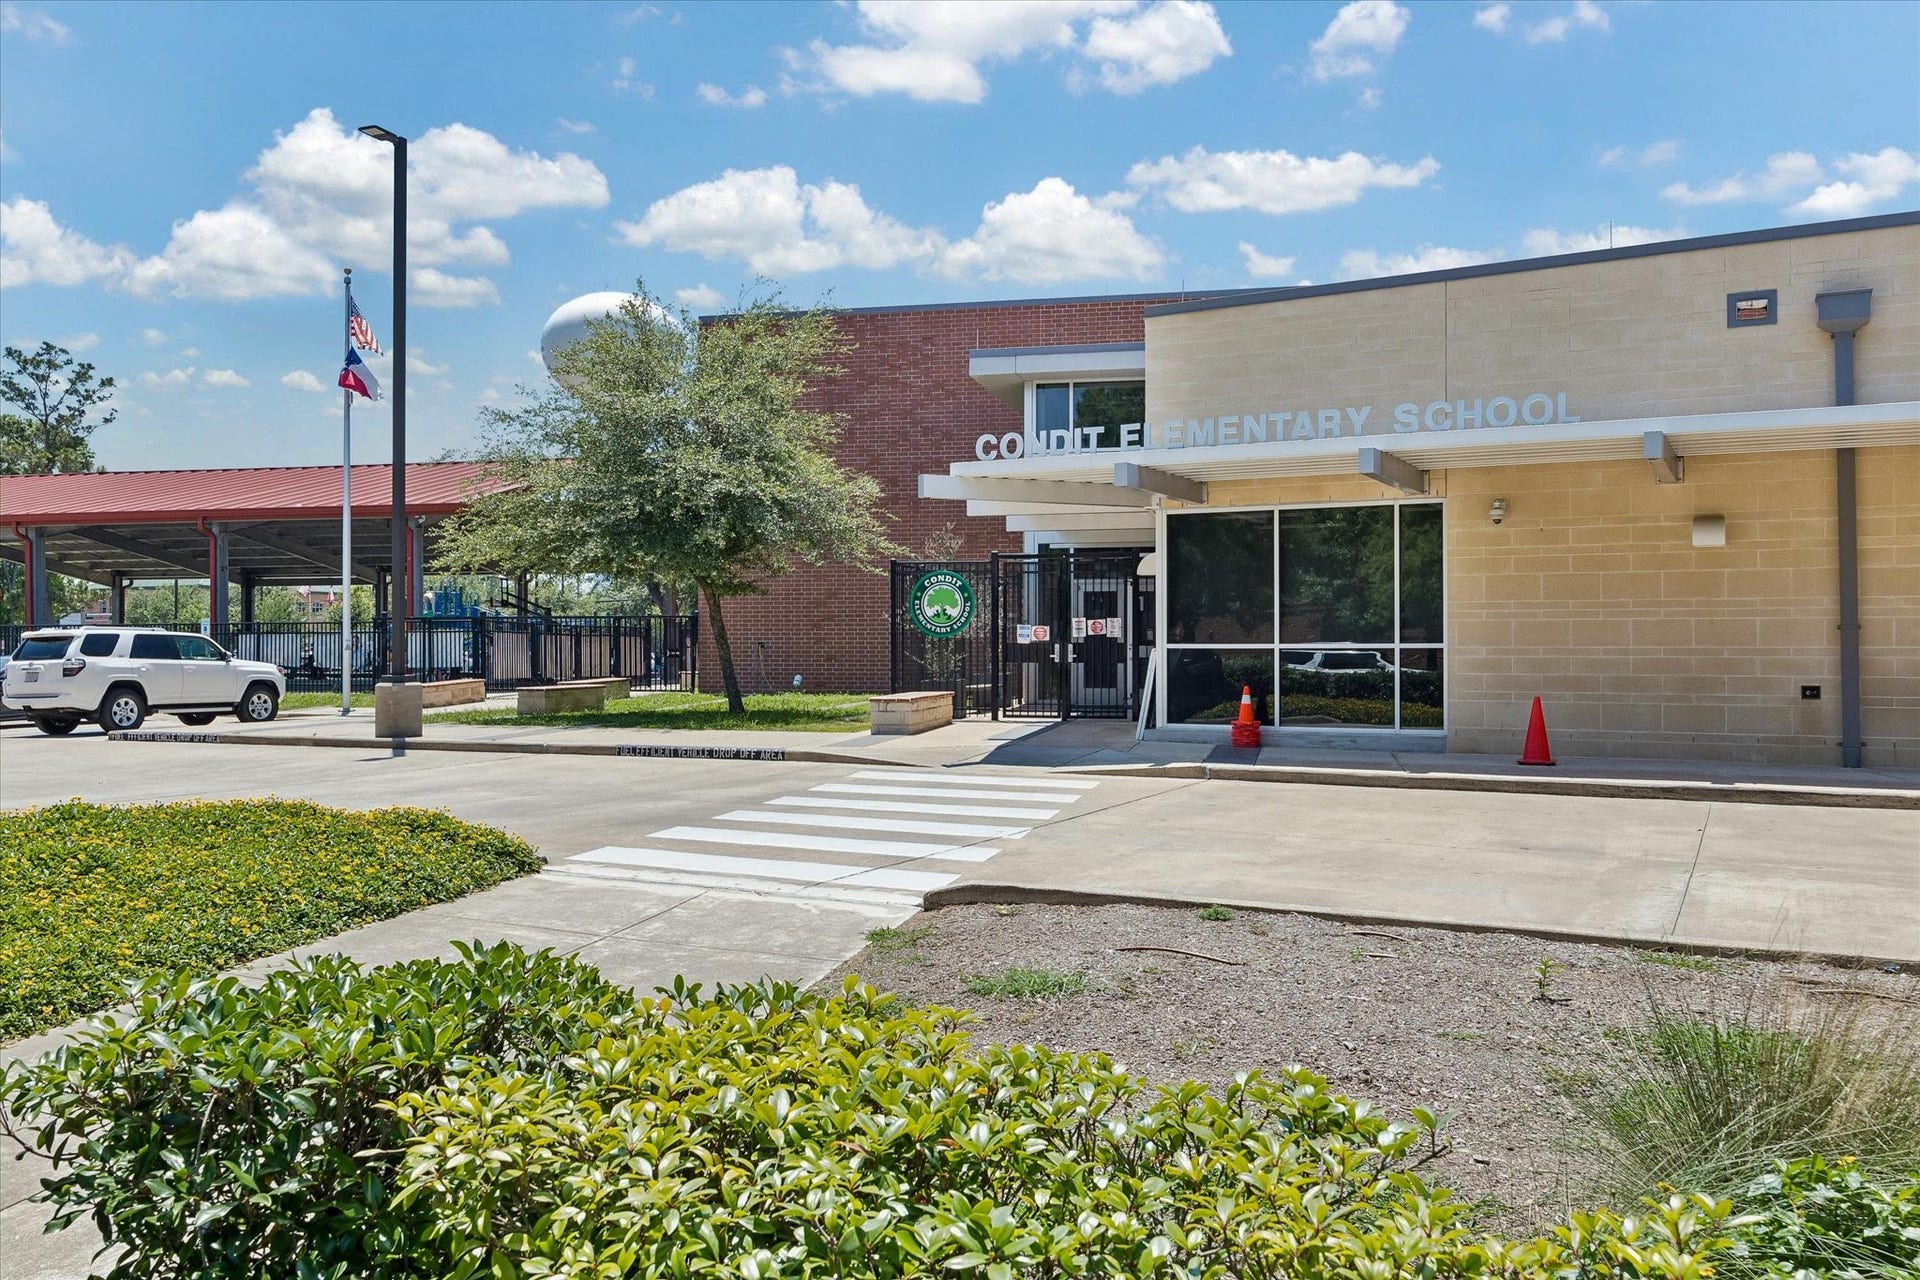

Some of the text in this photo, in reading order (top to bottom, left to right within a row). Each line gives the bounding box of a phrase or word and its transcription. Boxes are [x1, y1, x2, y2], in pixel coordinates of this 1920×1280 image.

[975, 391, 1581, 461] CONDIT ELEMENTARY SCHOOL
[924, 575, 962, 587] CONDIT
[914, 600, 971, 633] ELEMENTARY SCHOOL
[615, 745, 635, 756] FUEL
[713, 747, 737, 758] DROP
[740, 748, 757, 759] OFF
[760, 748, 783, 760] AREA
